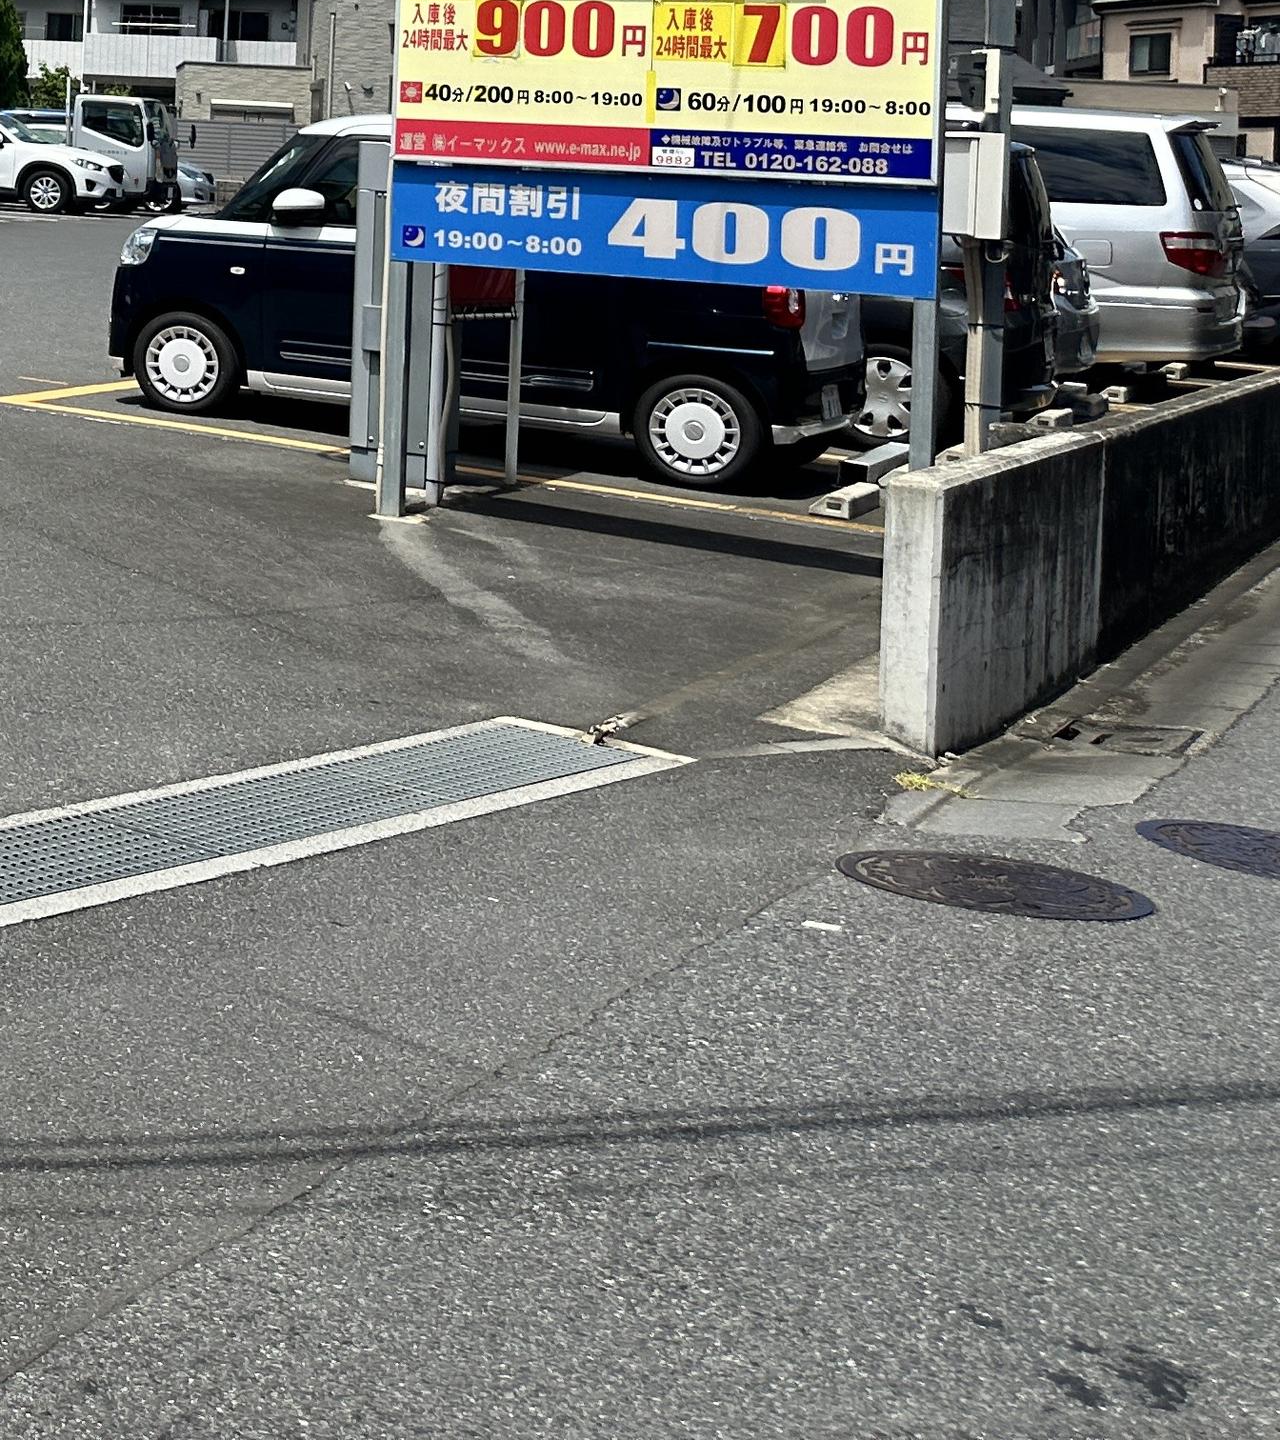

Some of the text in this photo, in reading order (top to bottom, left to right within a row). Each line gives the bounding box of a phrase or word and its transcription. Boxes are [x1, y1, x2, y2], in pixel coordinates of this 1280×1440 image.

[412, 3, 456, 26] 入庫後
[666, 7, 714, 32] 入庫後
[402, 29, 469, 51] 24時間最大
[655, 35, 728, 60] 24時間最大
[534, 141, 641, 162] www.e-max.ne.jp
[701, 150, 888, 175] TEL 0120-162-088
[435, 181, 580, 220] 夜間割引
